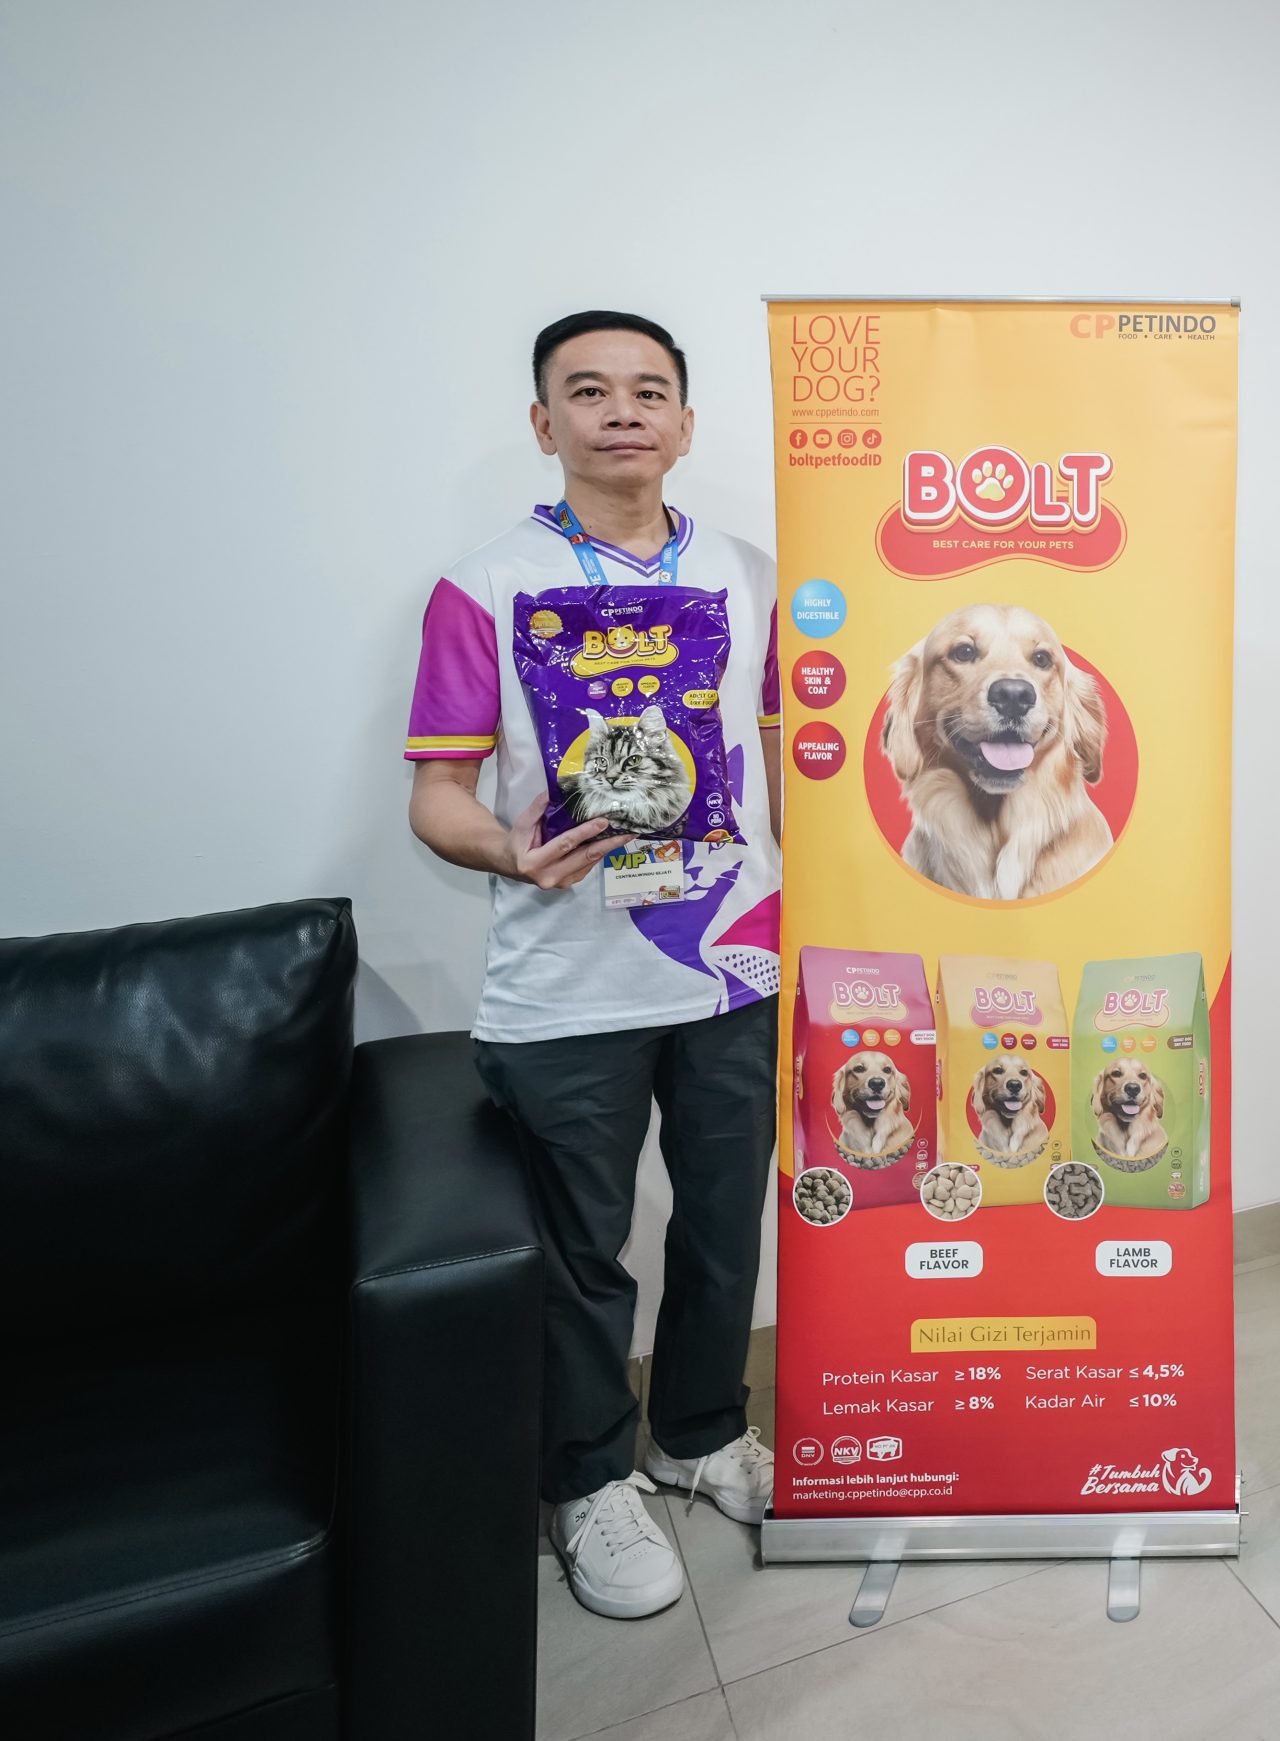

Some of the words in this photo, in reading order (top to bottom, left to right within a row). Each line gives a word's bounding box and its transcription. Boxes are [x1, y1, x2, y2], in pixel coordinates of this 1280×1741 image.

[793, 315, 880, 344] LOVE
[1070, 313, 1116, 339] CP
[1118, 314, 1216, 333] PETINDO
[791, 346, 880, 373] YOUR
[793, 375, 880, 402] DOG?
[791, 407, 880, 419] www.cppetindo.com
[789, 453, 882, 469] boltpetfoodID
[903, 445, 1114, 528] BOLT
[932, 540, 959, 549] BEST
[962, 540, 991, 549] CARE
[993, 541, 1015, 549] FOR
[1018, 541, 1047, 549] YOUR
[1049, 541, 1074, 550] PETS
[804, 598, 832, 608] HIGHLY
[797, 611, 840, 620] DIGESTIBLE
[582, 624, 673, 660] BOLT
[801, 667, 835, 676] HEALTHY
[804, 676, 821, 685] SKIN
[824, 677, 831, 685] &
[808, 686, 827, 695] COAT
[798, 742, 839, 751] APPEALING
[804, 751, 832, 760] FLAVOR
[609, 851, 647, 870] VIP
[832, 980, 901, 1008] BOLT
[974, 985, 1037, 1014] BOLT
[1103, 988, 1168, 1015] BOLT
[929, 1248, 959, 1259] BEEF
[1116, 1247, 1151, 1257] LAMB
[919, 1259, 969, 1271] FLAVOR
[1109, 1258, 1159, 1269] FLAVOR
[918, 1326, 963, 1344] Nilai
[970, 1326, 1008, 1343] Gizi
[1013, 1324, 1091, 1346] Terjamin
[822, 1370, 885, 1386] Protein
[890, 1368, 939, 1383] Kasar
[968, 1366, 1002, 1381] 18%
[1026, 1366, 1071, 1381] Serat
[1075, 1365, 1123, 1380] Kasar
[1142, 1364, 1185, 1381] 4,5%
[822, 1400, 881, 1415] Lemak
[886, 1398, 934, 1413] Kasar
[968, 1396, 995, 1411] 8%
[1025, 1394, 1077, 1410] Kadar
[1081, 1394, 1106, 1409] Air
[1142, 1393, 1177, 1408] 10%
[833, 1446, 859, 1457] NKV
[792, 1475, 845, 1487] Informasi
[846, 1474, 874, 1485] lebih
[876, 1473, 908, 1486] lanjut
[910, 1472, 959, 1484] hubungi:
[1089, 1463, 1160, 1480] #Tumbuh
[792, 1486, 953, 1500] marketing.cppetindo@cpp.co.id
[1080, 1476, 1160, 1495] Bersama
